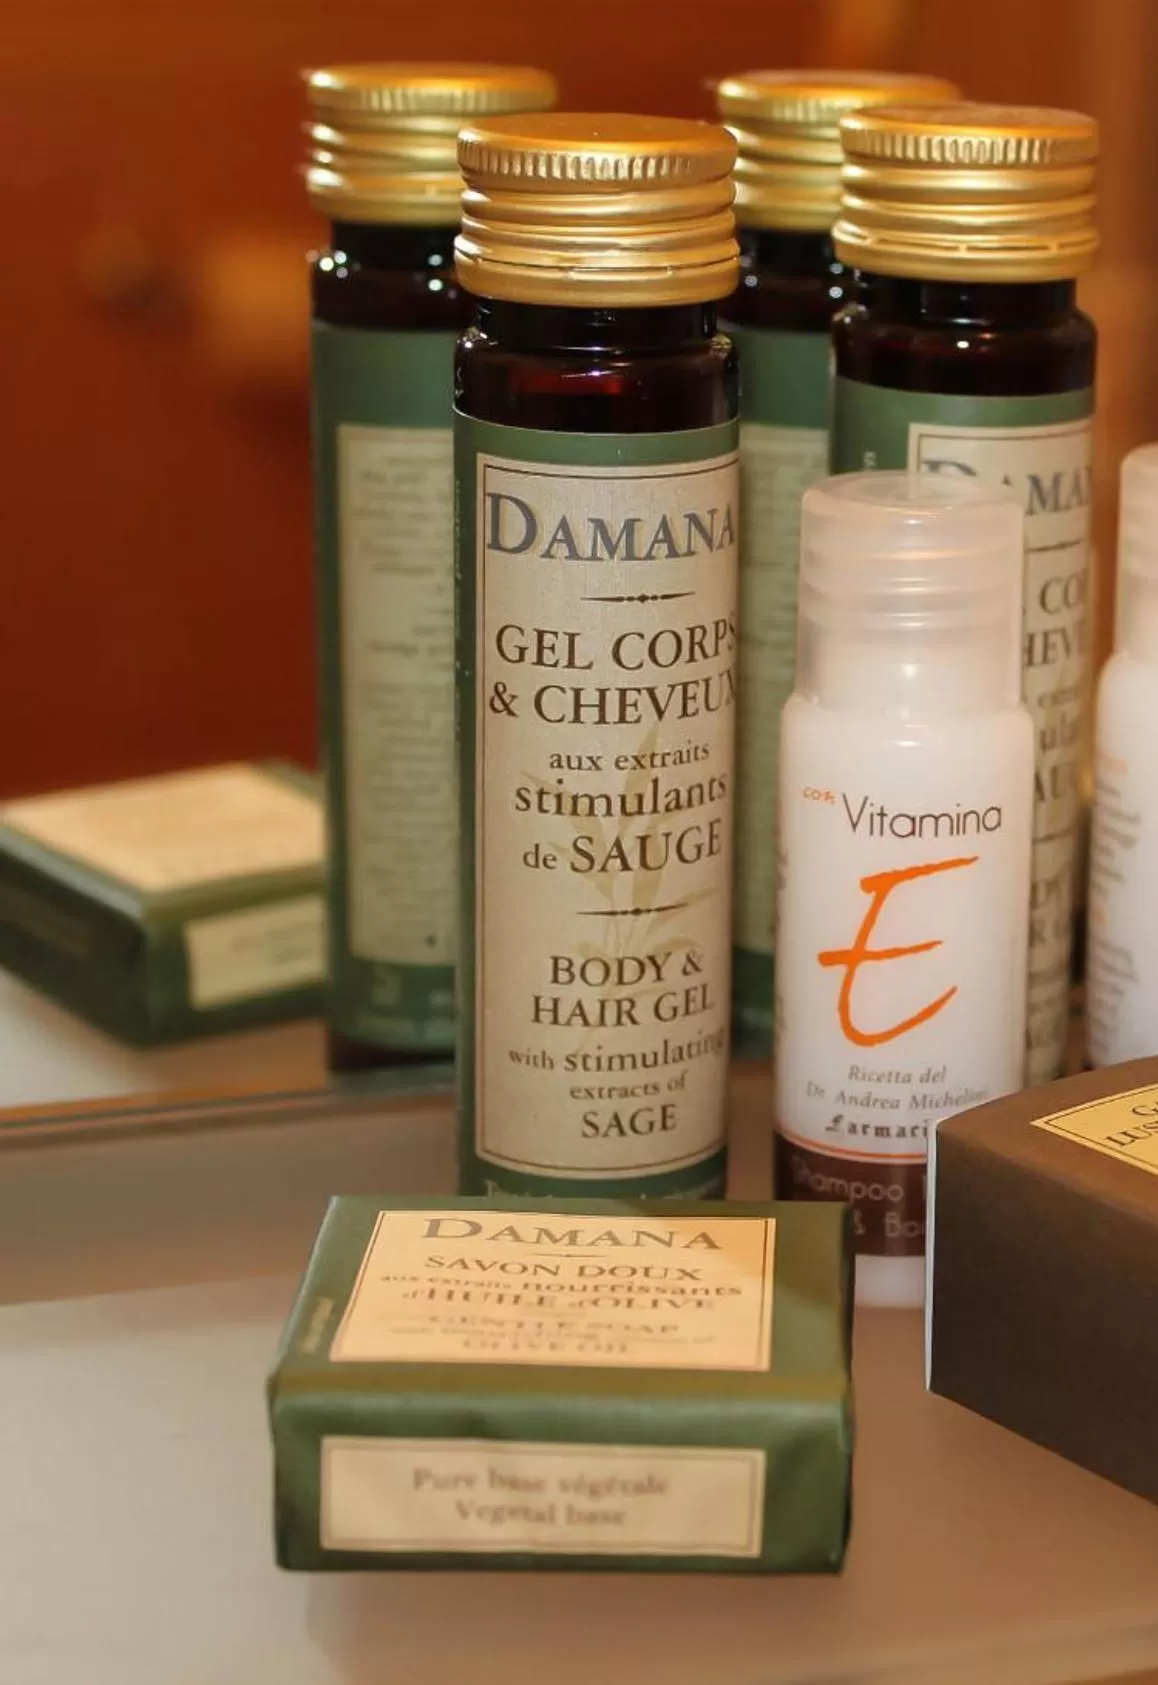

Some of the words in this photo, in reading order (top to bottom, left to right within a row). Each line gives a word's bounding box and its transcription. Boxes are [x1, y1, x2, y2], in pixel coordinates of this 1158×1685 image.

[486, 492, 735, 561] DAMANA
[496, 624, 594, 670] GEL
[489, 681, 519, 718] &
[549, 752, 602, 771] aux
[614, 739, 710, 771] extraits
[515, 772, 727, 817] stimulants
[842, 792, 1002, 838] Vitamina
[523, 843, 557, 870] de
[570, 818, 722, 874] SAUGE
[550, 952, 671, 987] BODY
[681, 949, 703, 977] &
[817, 855, 980, 1047] E
[531, 994, 640, 1028] HAIR
[653, 983, 712, 1023] GEL
[508, 1047, 555, 1071] with
[848, 1064, 912, 1085] Ricetta
[919, 1065, 947, 1085] del
[569, 1080, 660, 1100] extracts
[667, 1068, 689, 1091] of
[834, 1089, 900, 1110] Andrea
[581, 1103, 677, 1139] SAGE
[421, 1218, 723, 1250] DAMANA
[425, 1255, 560, 1277] SAVON
[577, 1263, 702, 1281] DOUX
